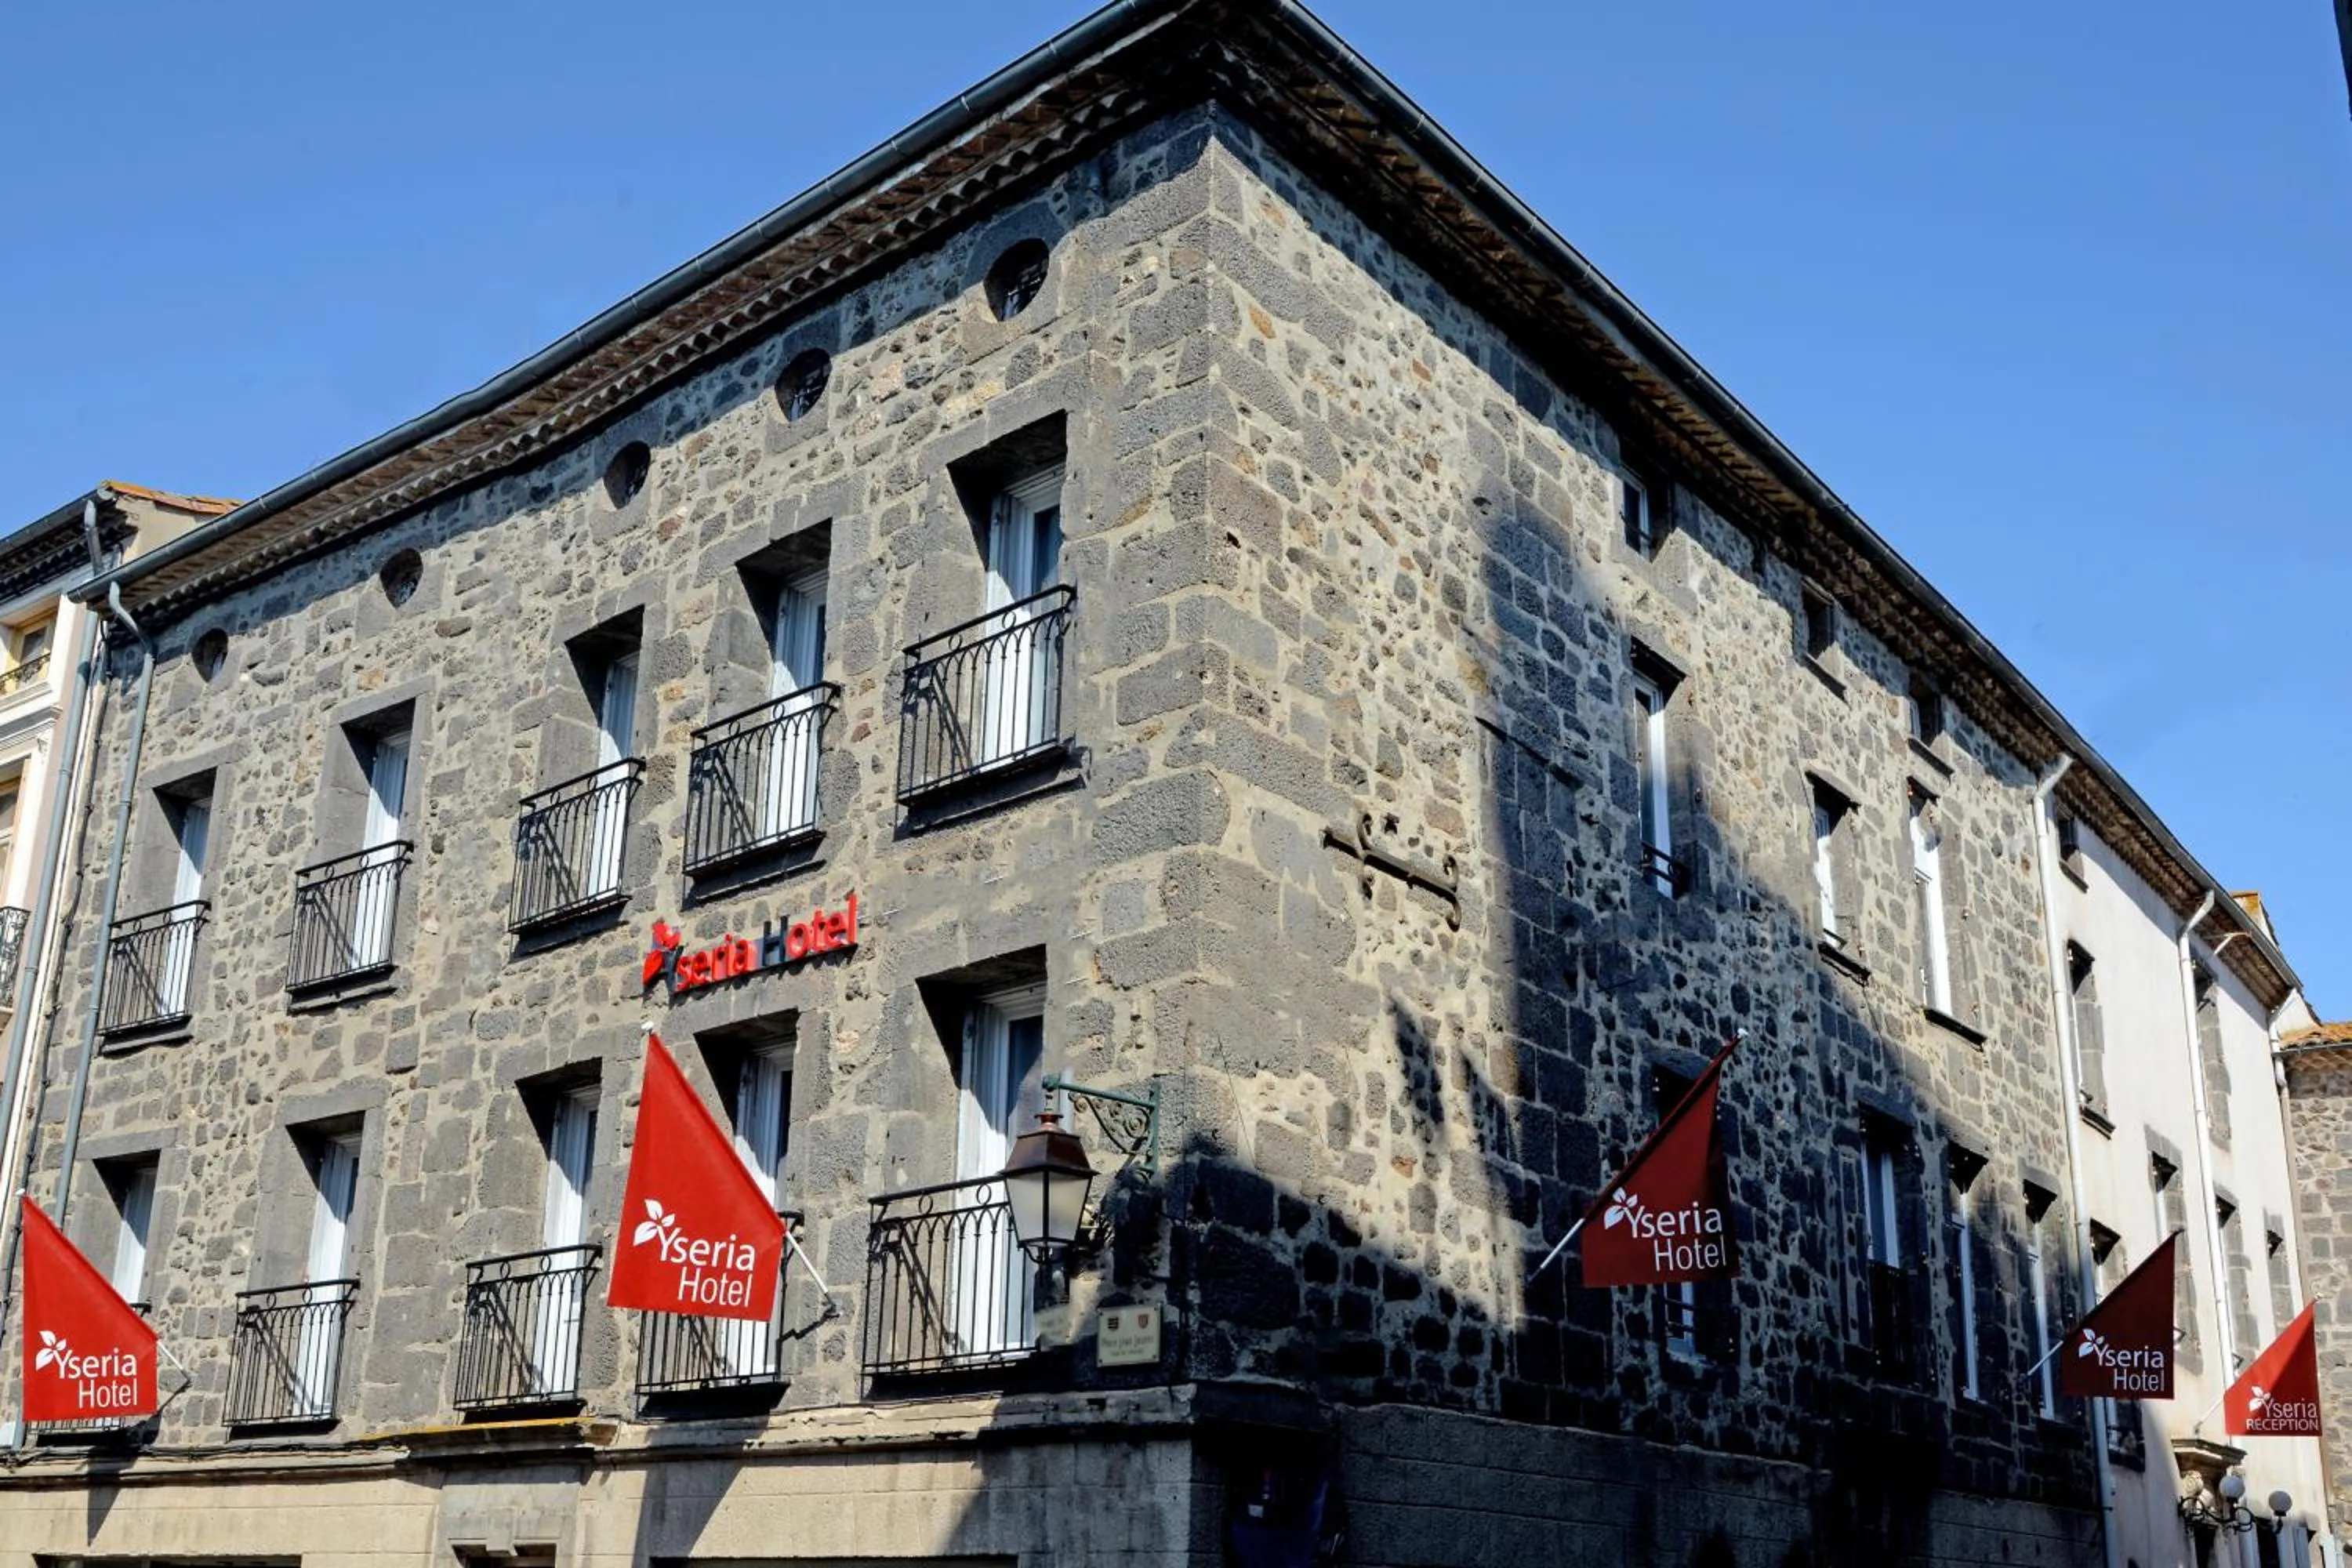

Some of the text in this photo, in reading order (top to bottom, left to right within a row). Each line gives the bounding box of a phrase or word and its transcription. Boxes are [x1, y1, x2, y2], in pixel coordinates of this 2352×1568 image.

[762, 891, 858, 967] Hotel
[1624, 1201, 1722, 1238] Yseria
[657, 1225, 756, 1271] Yseria
[1653, 1234, 1726, 1272] Hotel
[677, 1266, 753, 1308] Hotel
[53, 1348, 137, 1379] Yseria
[2093, 1344, 2165, 1368] Yseria
[78, 1378, 137, 1409] Hotel
[2113, 1368, 2165, 1392] Hotel
[2261, 1398, 2318, 1418] Yseria
